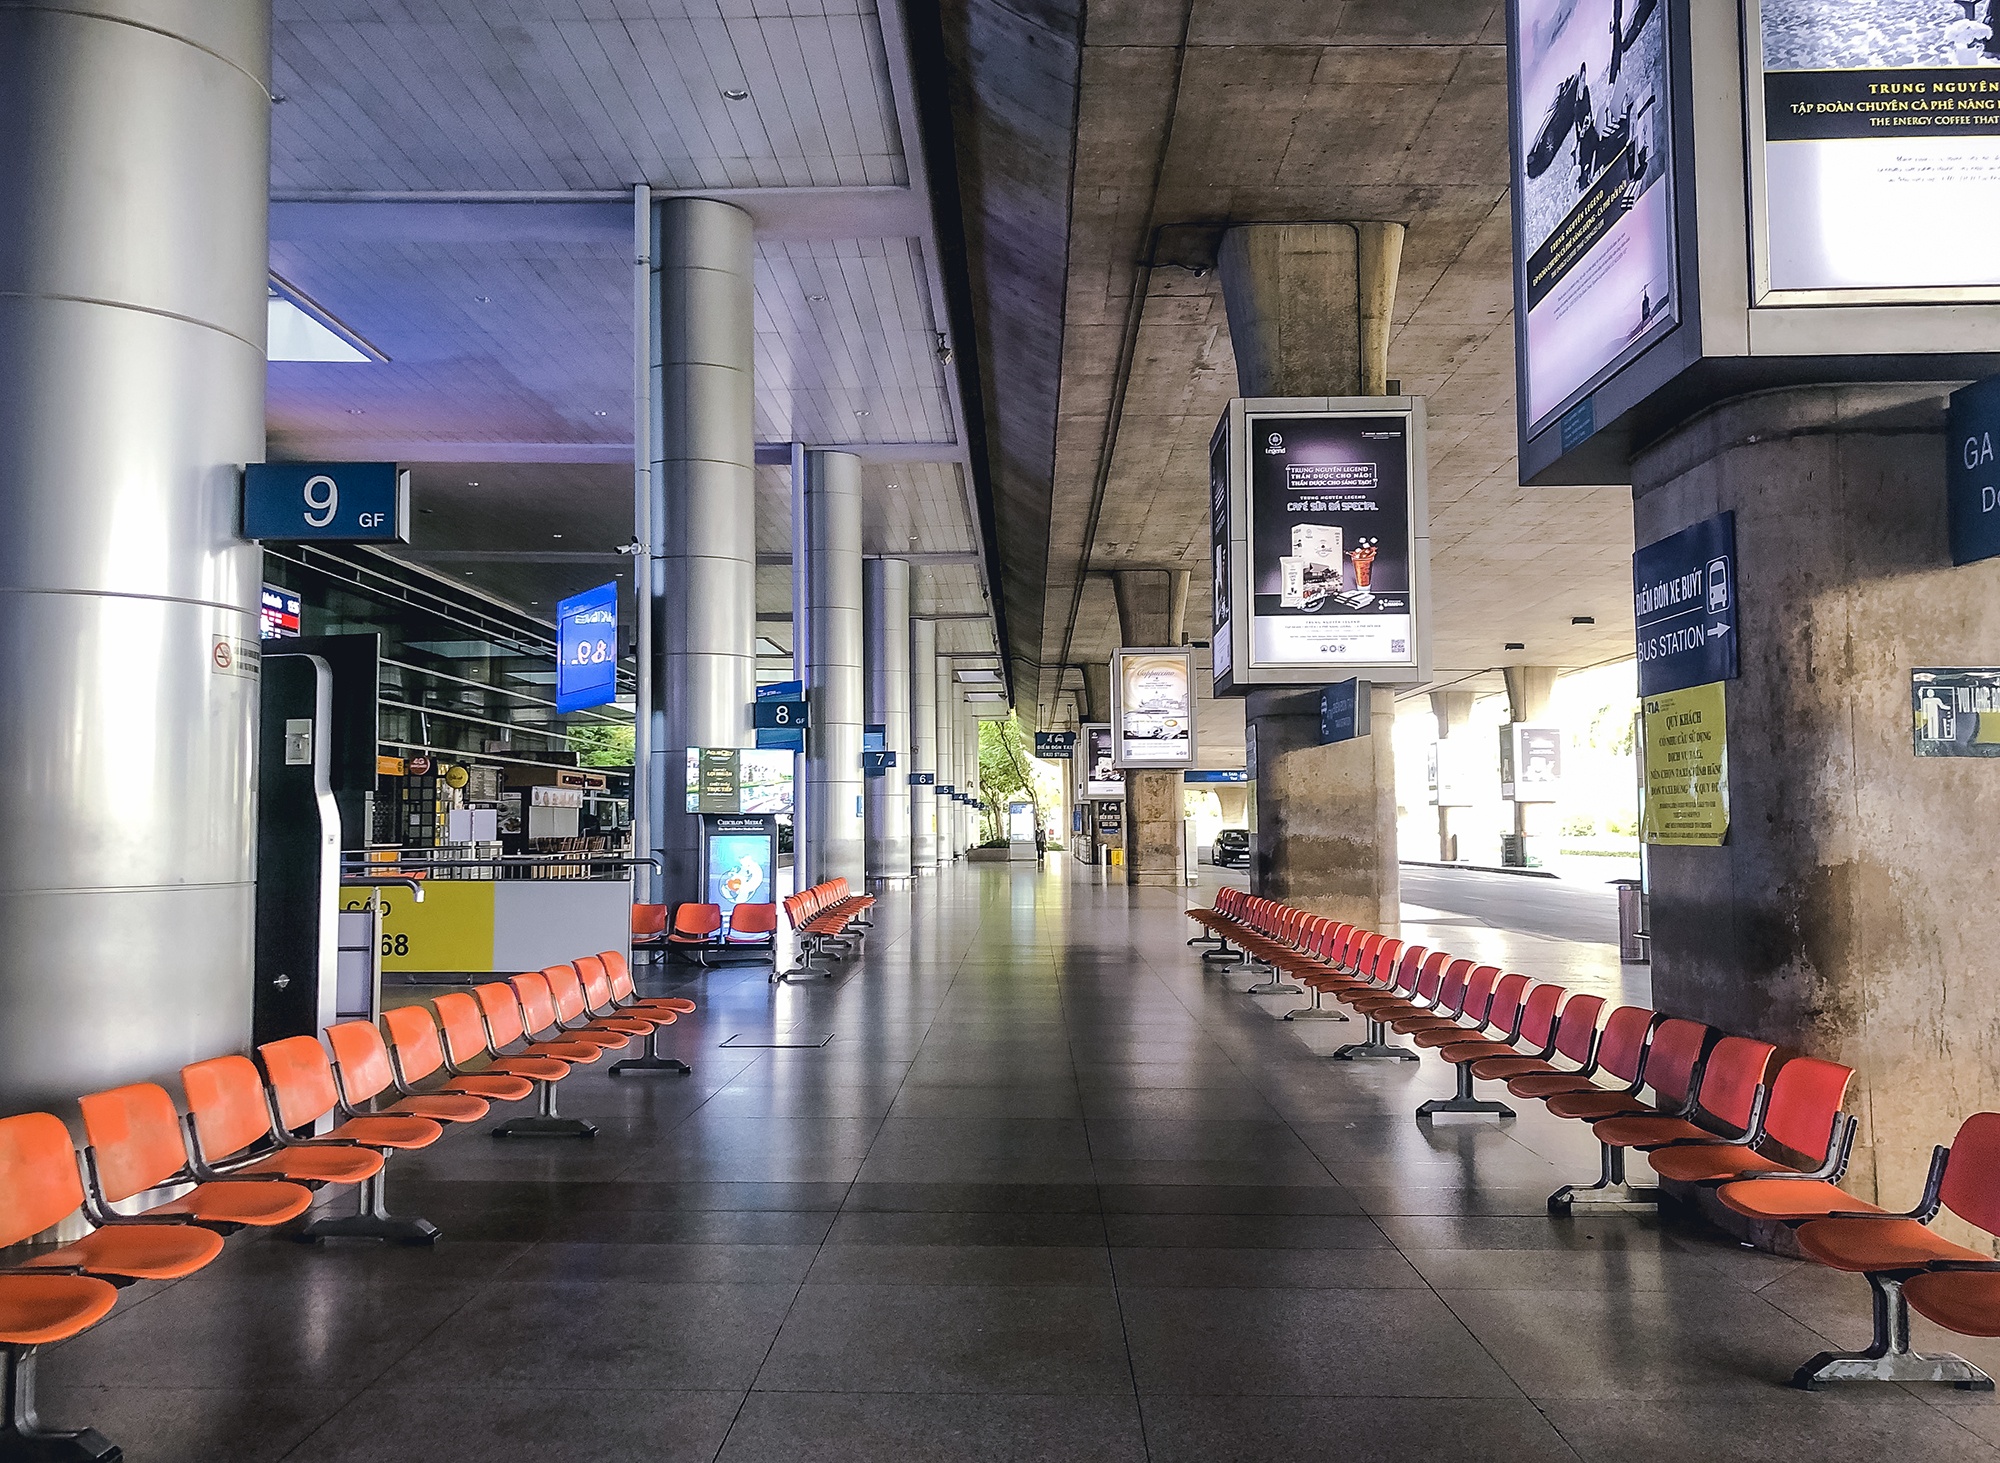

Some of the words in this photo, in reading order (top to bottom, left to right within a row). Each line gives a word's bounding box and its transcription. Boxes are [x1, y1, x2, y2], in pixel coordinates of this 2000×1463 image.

[1868, 83, 1926, 95] TRUNG
[1932, 79, 2000, 93] NGUYÊN
[1790, 101, 1814, 116] TẬP
[1816, 99, 1854, 113] ĐOÀN
[1856, 98, 1908, 112] CHUYÊN
[1931, 97, 1954, 111] PHÊ
[1869, 116, 1890, 126] THE
[1893, 116, 1932, 127] ENERGY
[1934, 115, 1971, 125] COFFEE
[1973, 115, 1999, 125] THAT
[1265, 447, 1286, 455] Legend
[1963, 431, 1994, 470] GA
[303, 475, 339, 527] 9
[358, 513, 385, 529] GF
[1636, 583, 1653, 617] ĐIỂM
[1669, 578, 1680, 604] XE
[1681, 566, 1703, 601] BUÝT
[1637, 638, 1658, 663] BUS
[1659, 623, 1705, 657] STATION
[1137, 669, 1175, 679] Cappuccino
[775, 705, 789, 724] 8
[795, 717, 805, 725] GF
[875, 753, 885, 766] 7
[920, 774, 926, 784] 6
[381, 933, 409, 957] 68
